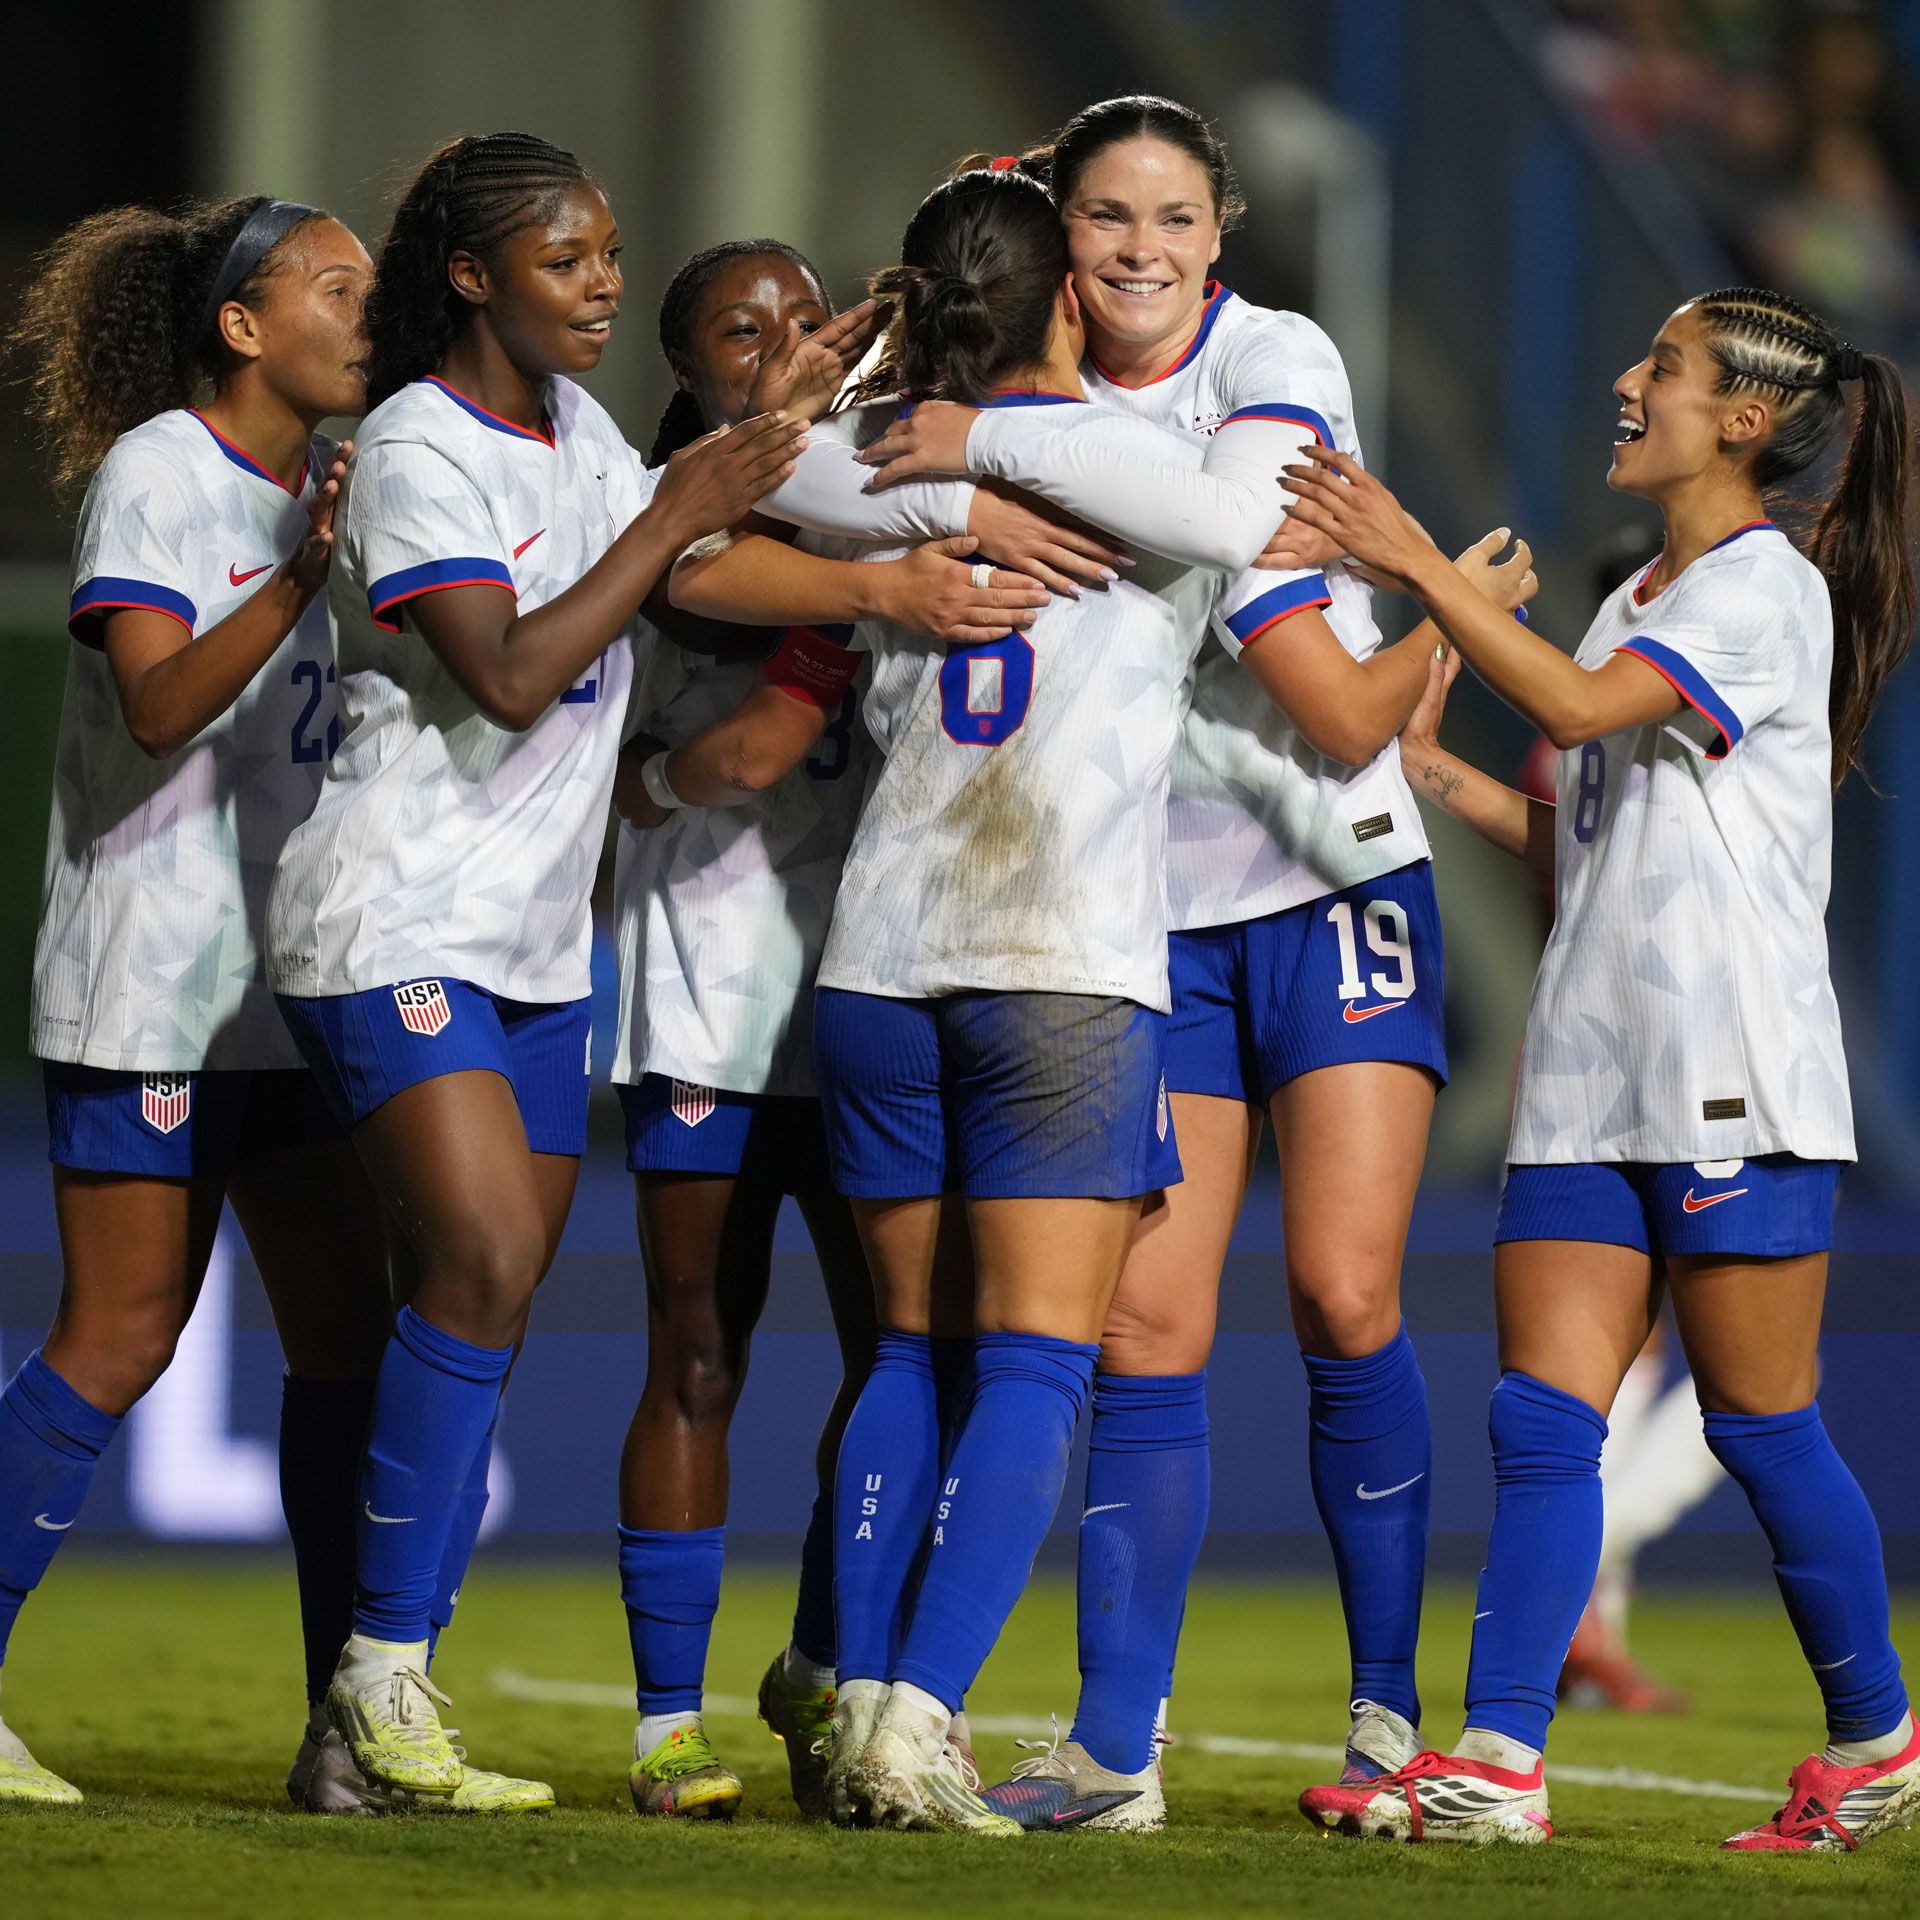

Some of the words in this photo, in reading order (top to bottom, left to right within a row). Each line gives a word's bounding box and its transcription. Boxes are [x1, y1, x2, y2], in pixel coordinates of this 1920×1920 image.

[792, 648, 810, 663] JAN
[1574, 741, 1606, 843] 8
[1327, 899, 1416, 1000] 19
[397, 982, 441, 1006] USA
[145, 1072, 188, 1097] USA
[855, 1473, 882, 1540] USA
[933, 1478, 960, 1546] USA
